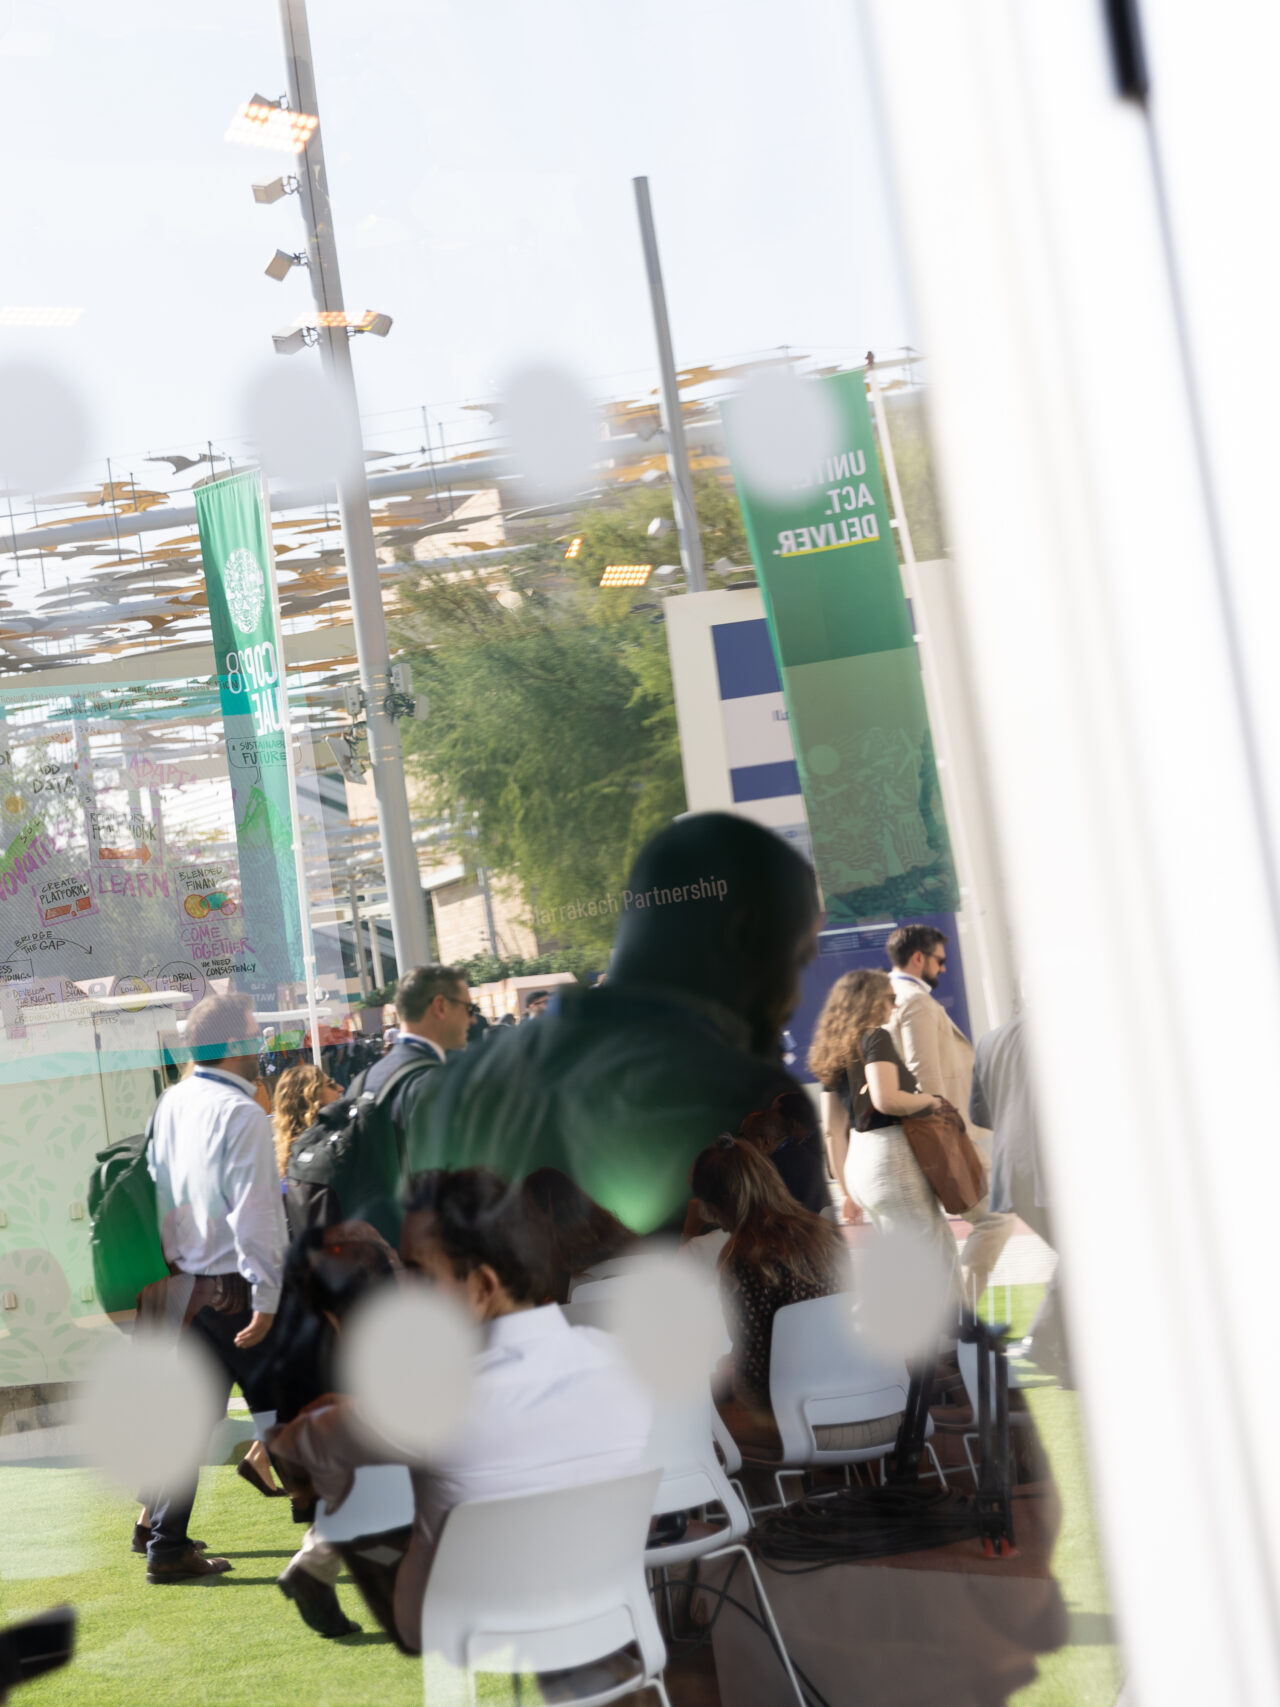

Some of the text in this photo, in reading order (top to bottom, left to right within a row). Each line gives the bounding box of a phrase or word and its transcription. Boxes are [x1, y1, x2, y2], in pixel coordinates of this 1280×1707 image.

[98, 871, 170, 898] LEARN
[623, 874, 728, 911] Partnership
[14, 930, 54, 947] BRIDGE
[180, 926, 221, 942] COME
[39, 939, 67, 951] GAP
[184, 936, 257, 960] TOGETHER
[206, 962, 257, 977] CONSISTENCY
[162, 972, 197, 984] GLOBAL
